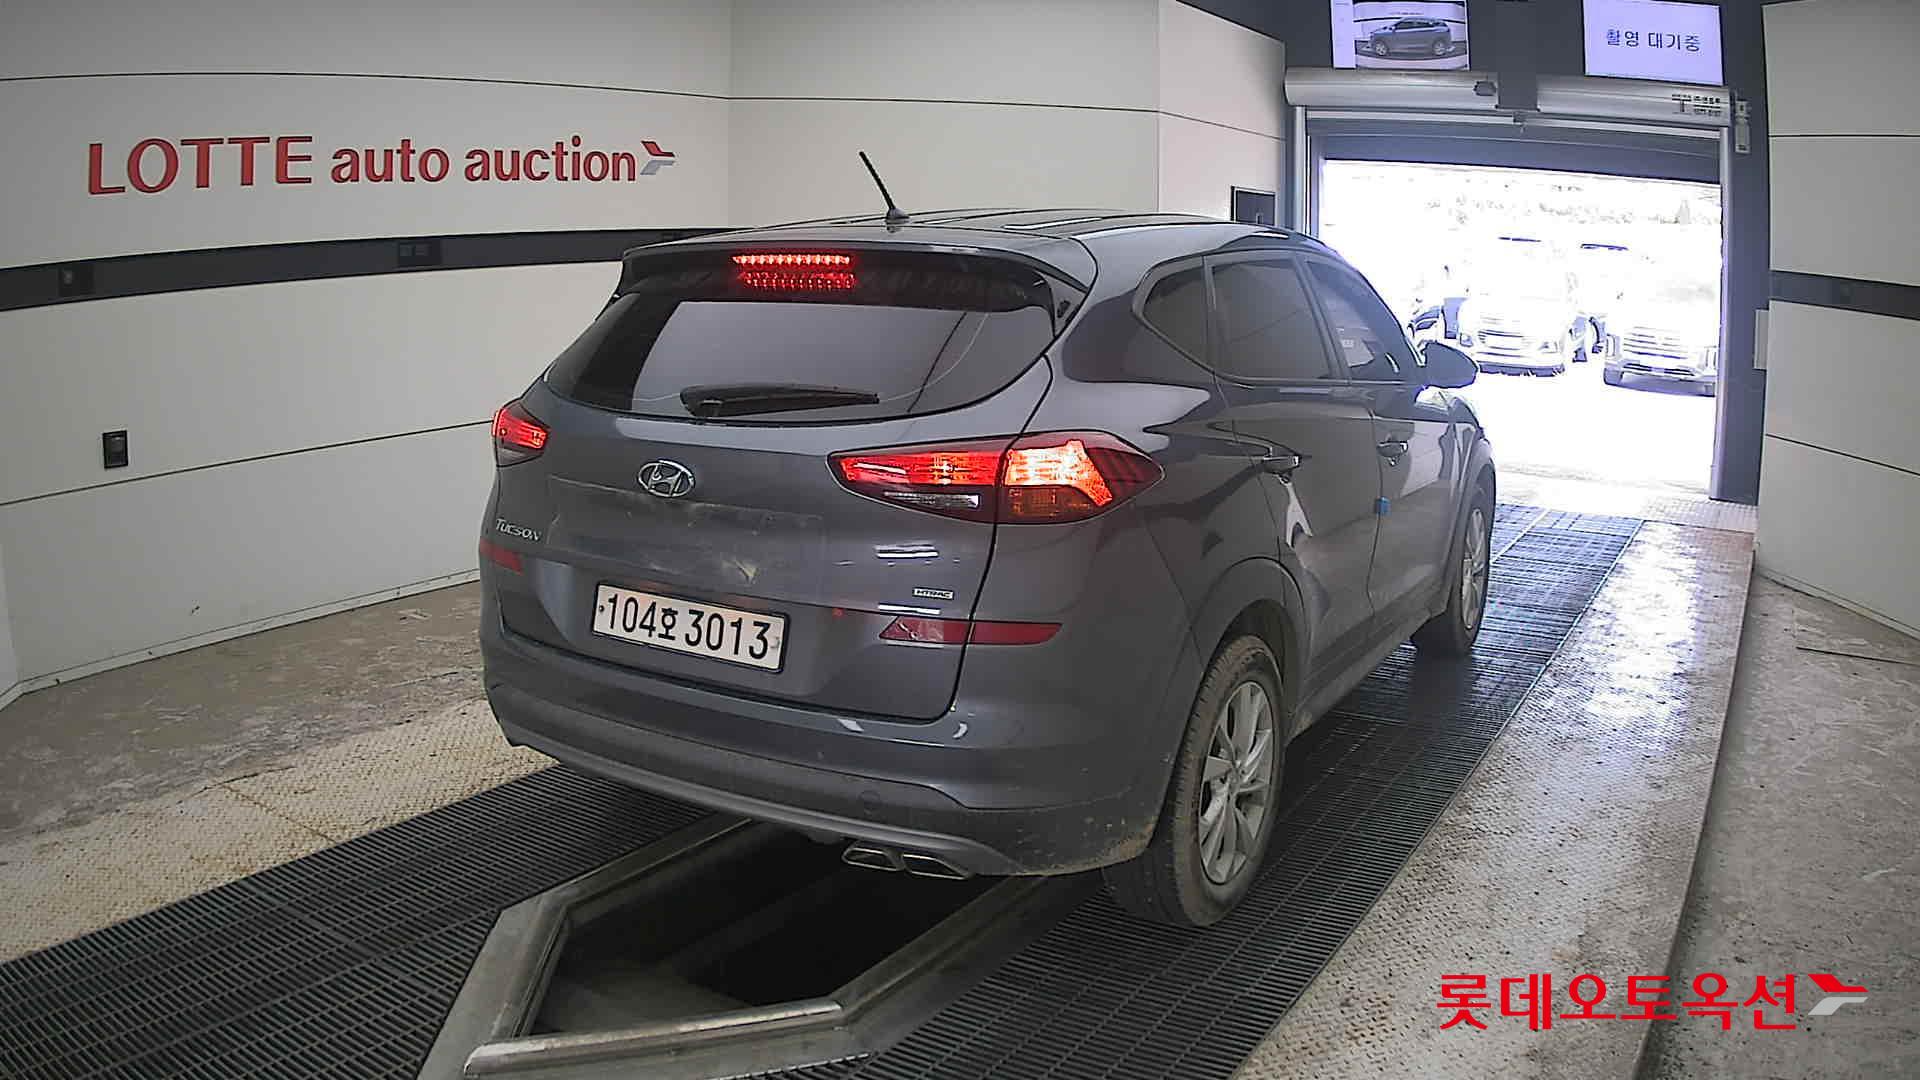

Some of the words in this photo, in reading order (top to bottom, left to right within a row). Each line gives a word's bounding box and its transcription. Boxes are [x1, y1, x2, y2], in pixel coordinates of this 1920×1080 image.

[1648, 31, 1700, 52] 대기중
[88, 136, 313, 195] LOTTE
[330, 138, 450, 183] auto
[464, 135, 636, 182] auction
[684, 609, 771, 660] 3013
